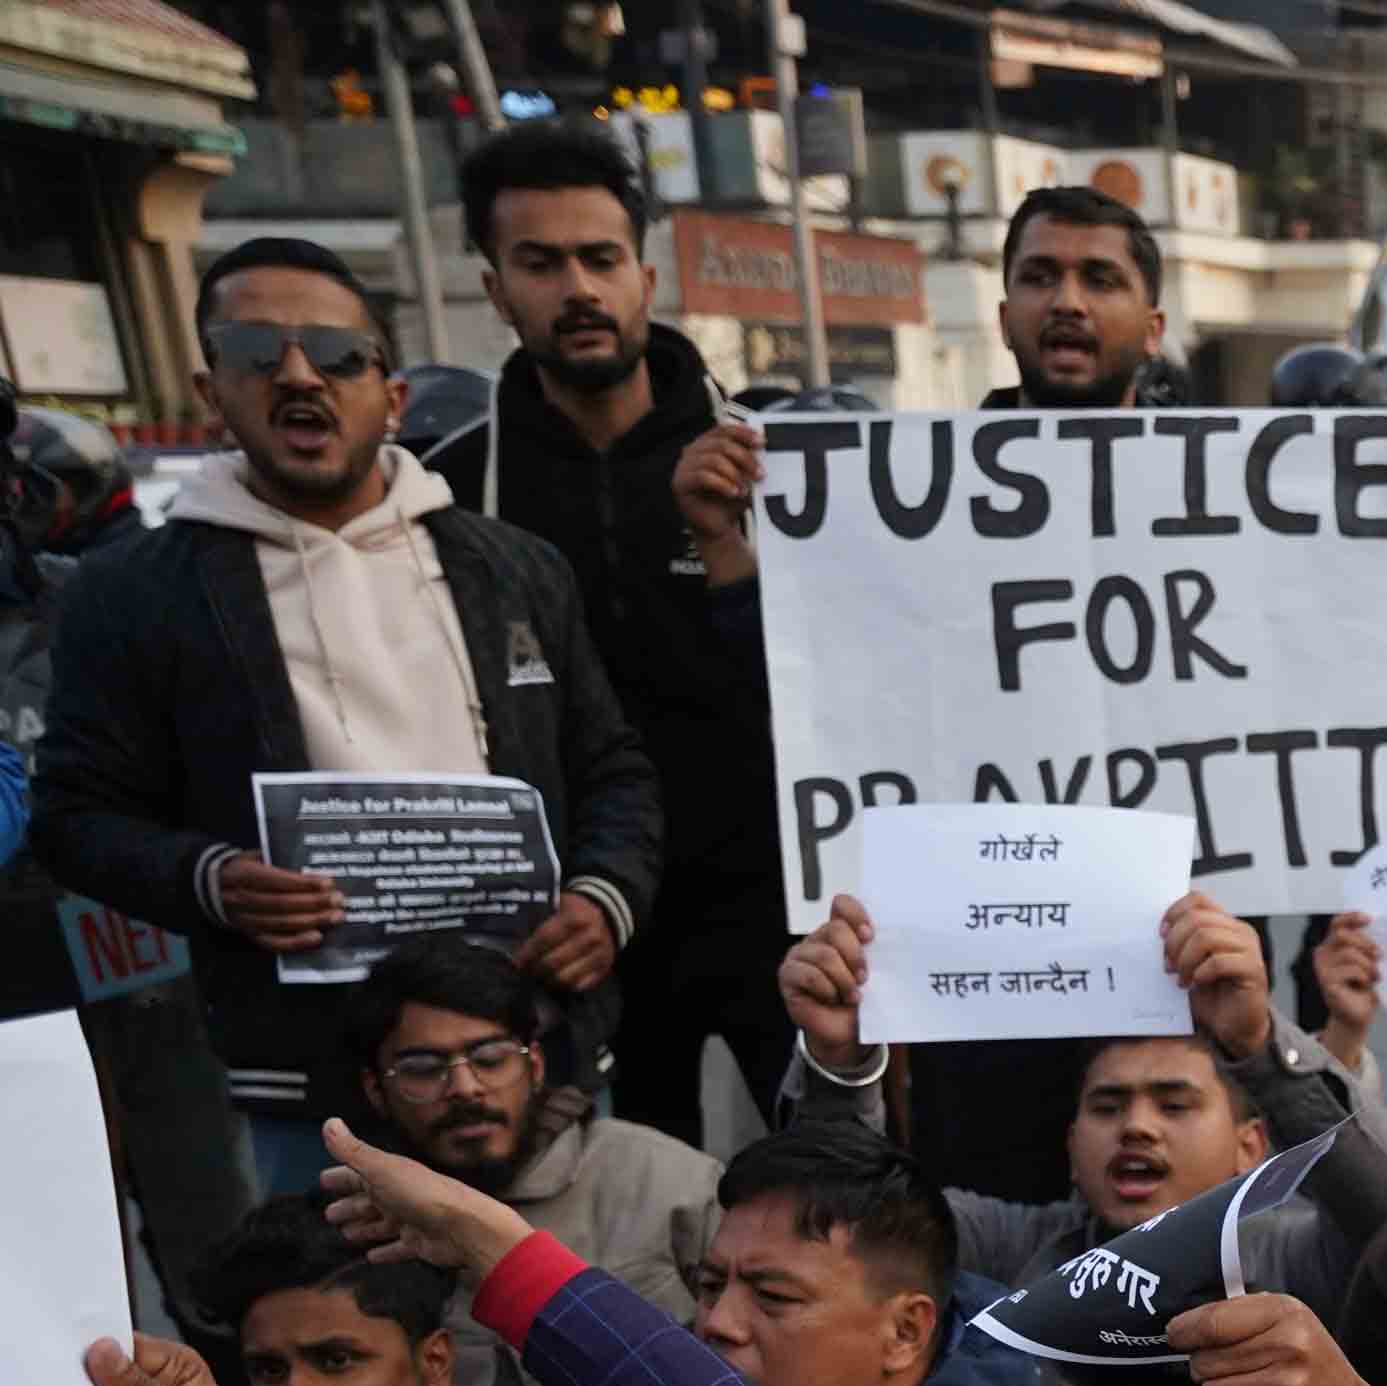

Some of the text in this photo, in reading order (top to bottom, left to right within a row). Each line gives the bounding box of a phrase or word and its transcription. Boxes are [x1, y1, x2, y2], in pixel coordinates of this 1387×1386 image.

[991, 569, 1248, 692] FOR
[964, 902, 1071, 931] अन्याय
[929, 970, 994, 999] सहन
[999, 961, 1090, 998] जान्दैन
[1117, 1259, 1161, 1316] गर
